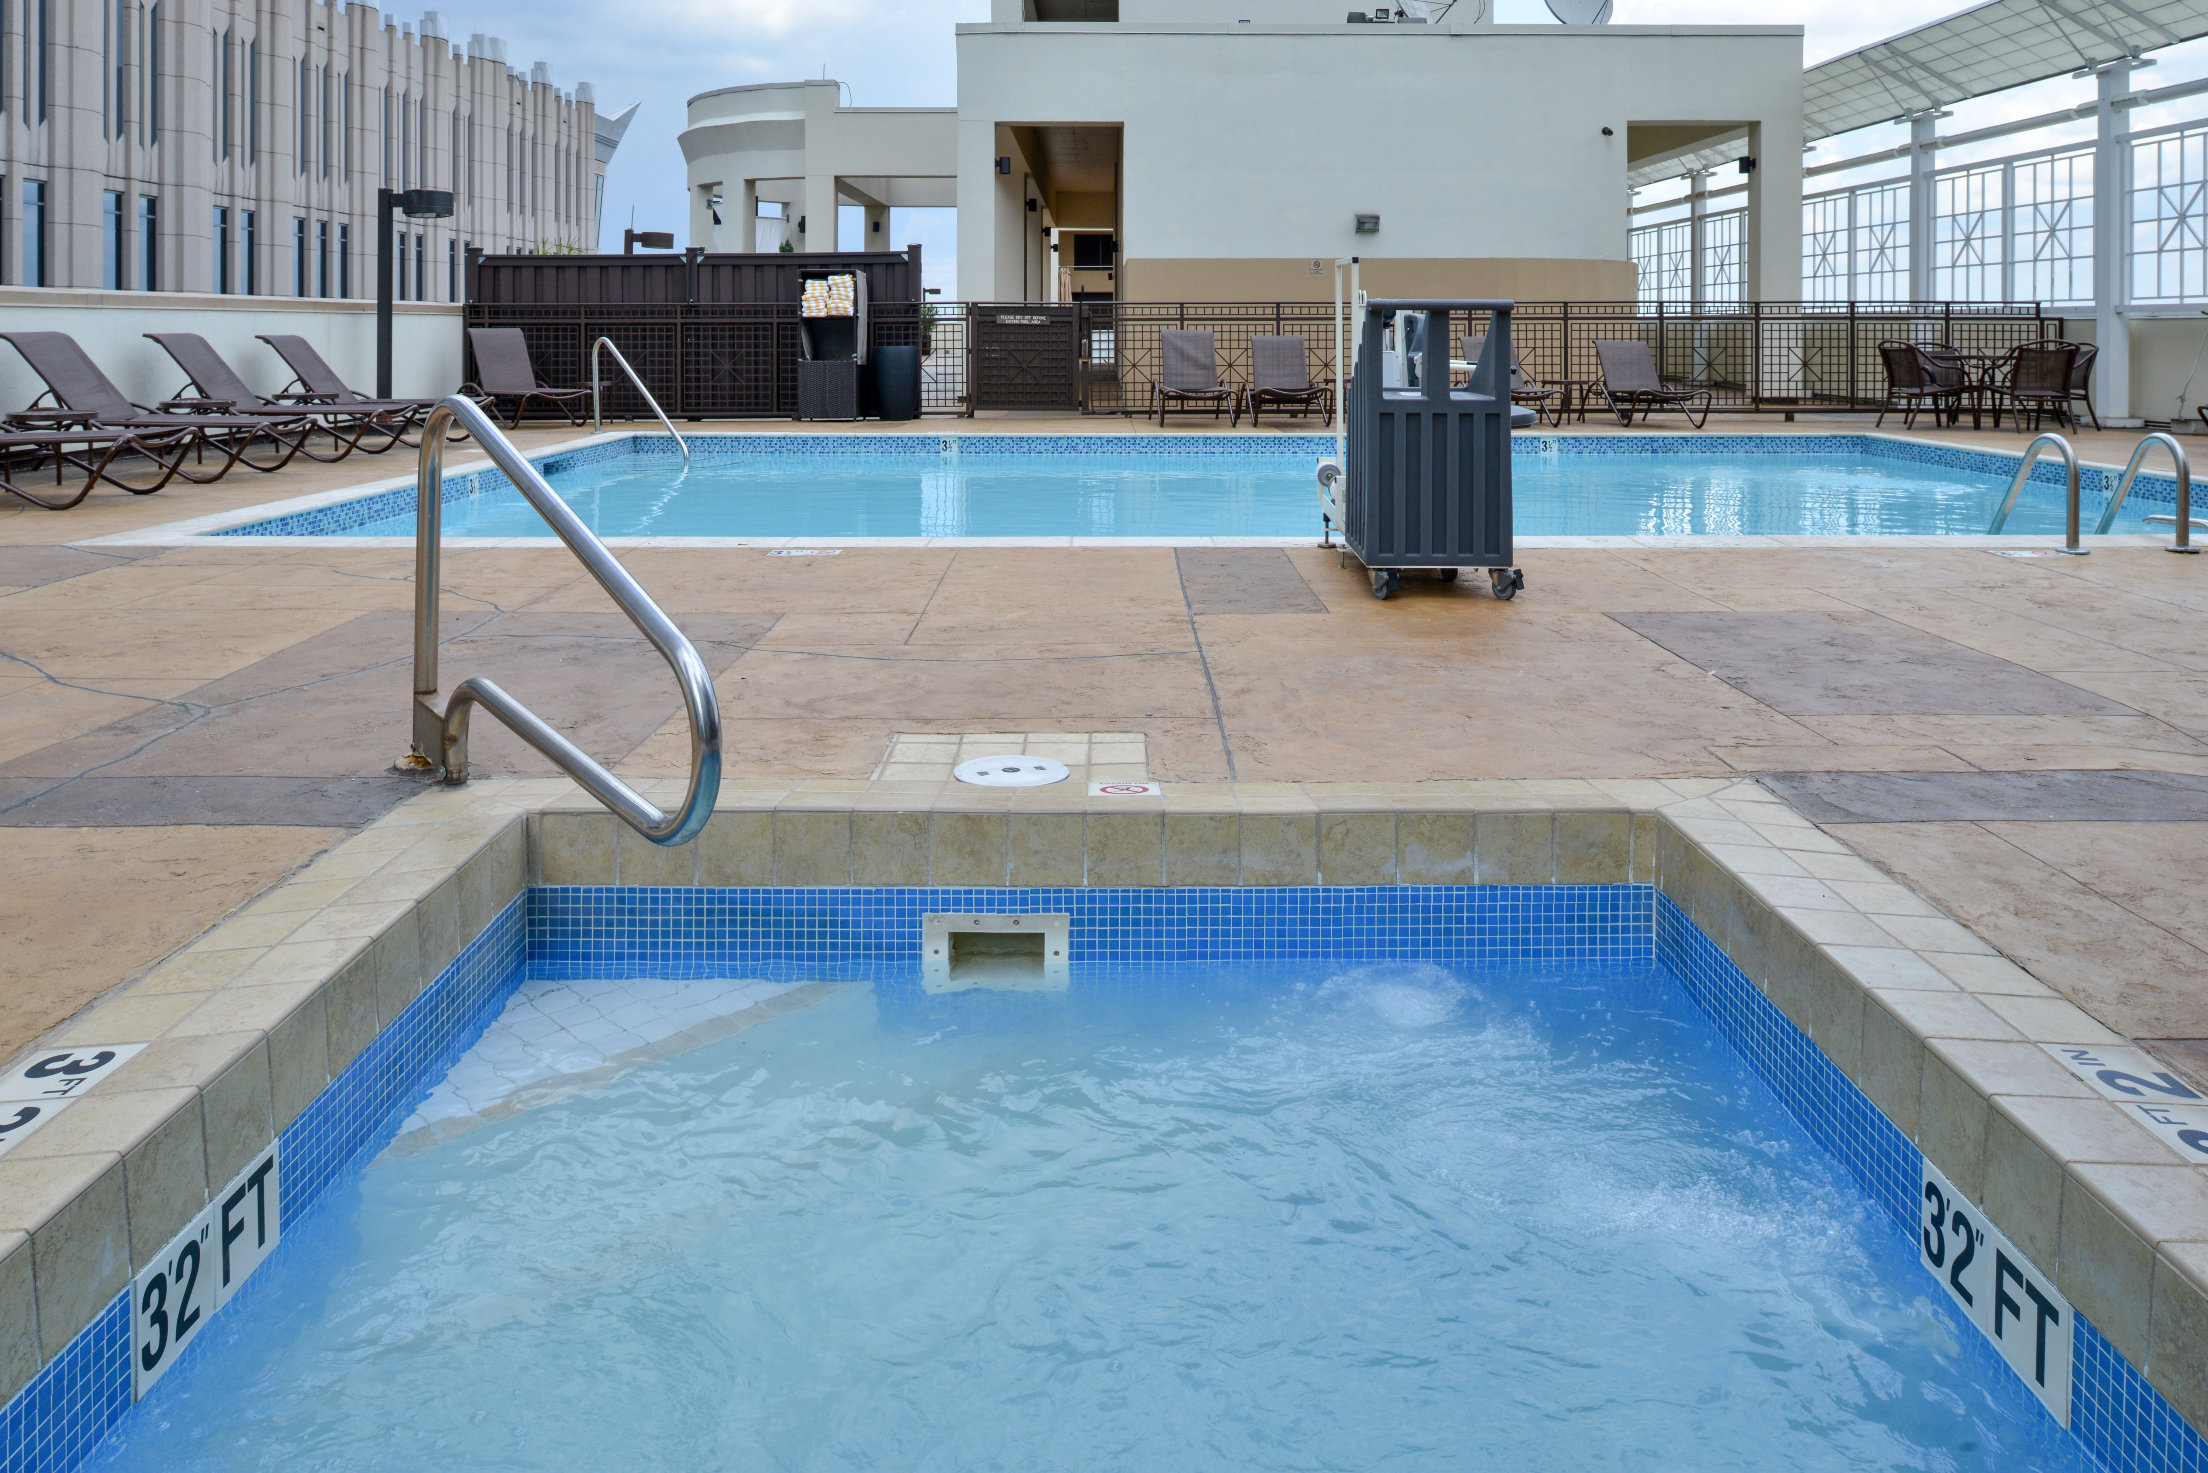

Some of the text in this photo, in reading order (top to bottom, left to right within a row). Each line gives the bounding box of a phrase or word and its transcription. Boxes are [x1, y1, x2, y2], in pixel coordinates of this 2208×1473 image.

[24, 1050, 117, 1096] 3 FT
[2060, 1049, 2204, 1126] FT 2 IN
[221, 1153, 274, 1290] FT
[1993, 1247, 2060, 1390] FT
